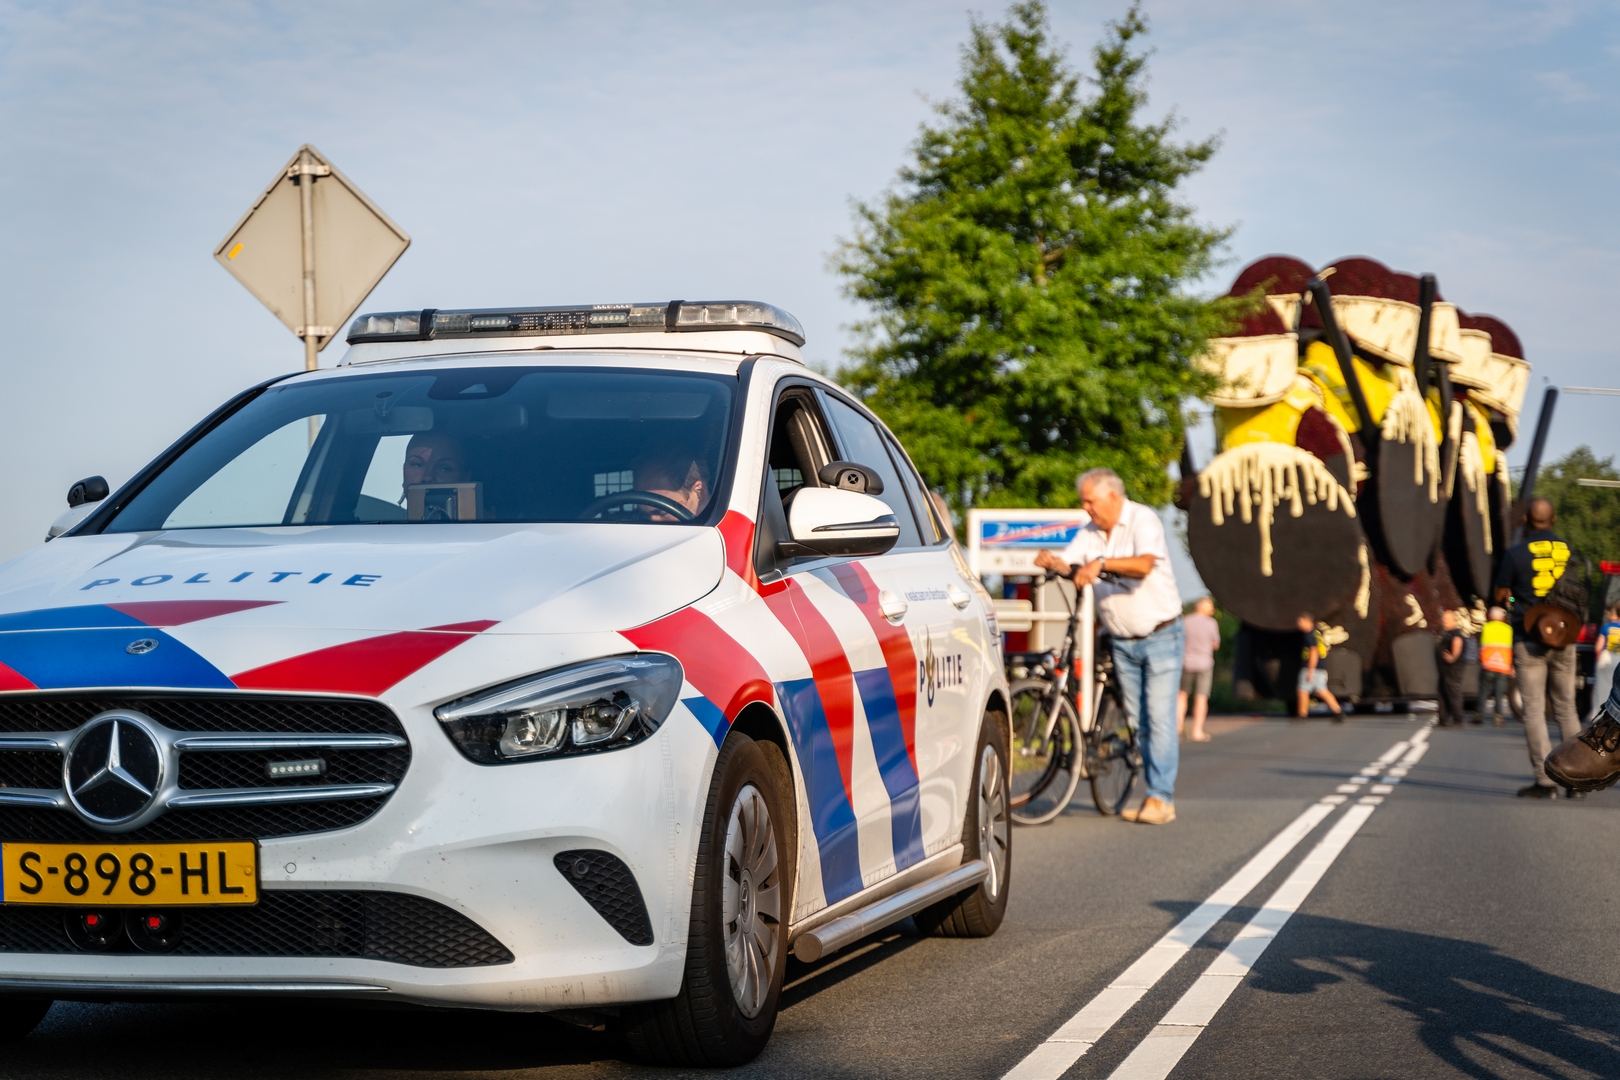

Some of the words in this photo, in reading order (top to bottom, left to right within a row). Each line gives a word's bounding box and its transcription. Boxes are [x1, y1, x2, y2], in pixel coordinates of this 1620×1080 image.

[79, 571, 383, 591] POLITIE
[919, 653, 963, 708] POLITIE
[19, 851, 245, 896] S-898-HL
